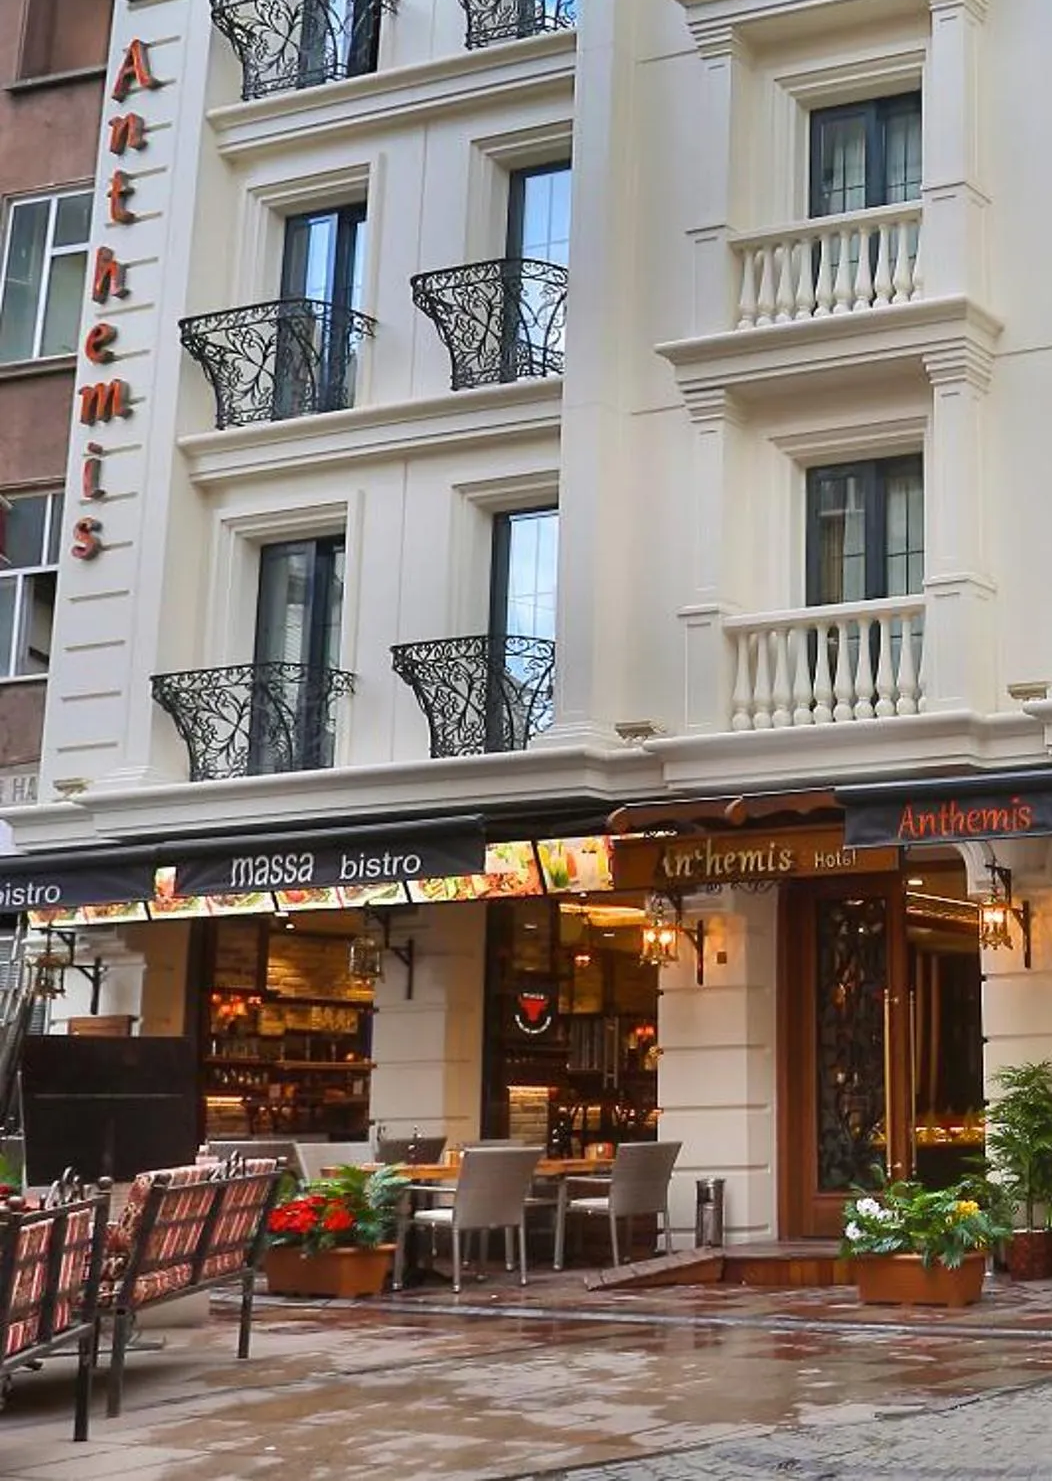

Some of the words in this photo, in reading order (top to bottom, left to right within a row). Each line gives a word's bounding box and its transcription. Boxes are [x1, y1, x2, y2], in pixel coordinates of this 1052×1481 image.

[70, 37, 158, 564] Anthemis
[897, 794, 1034, 839] Anthemis
[230, 852, 315, 888] massa
[338, 851, 422, 880] bistro
